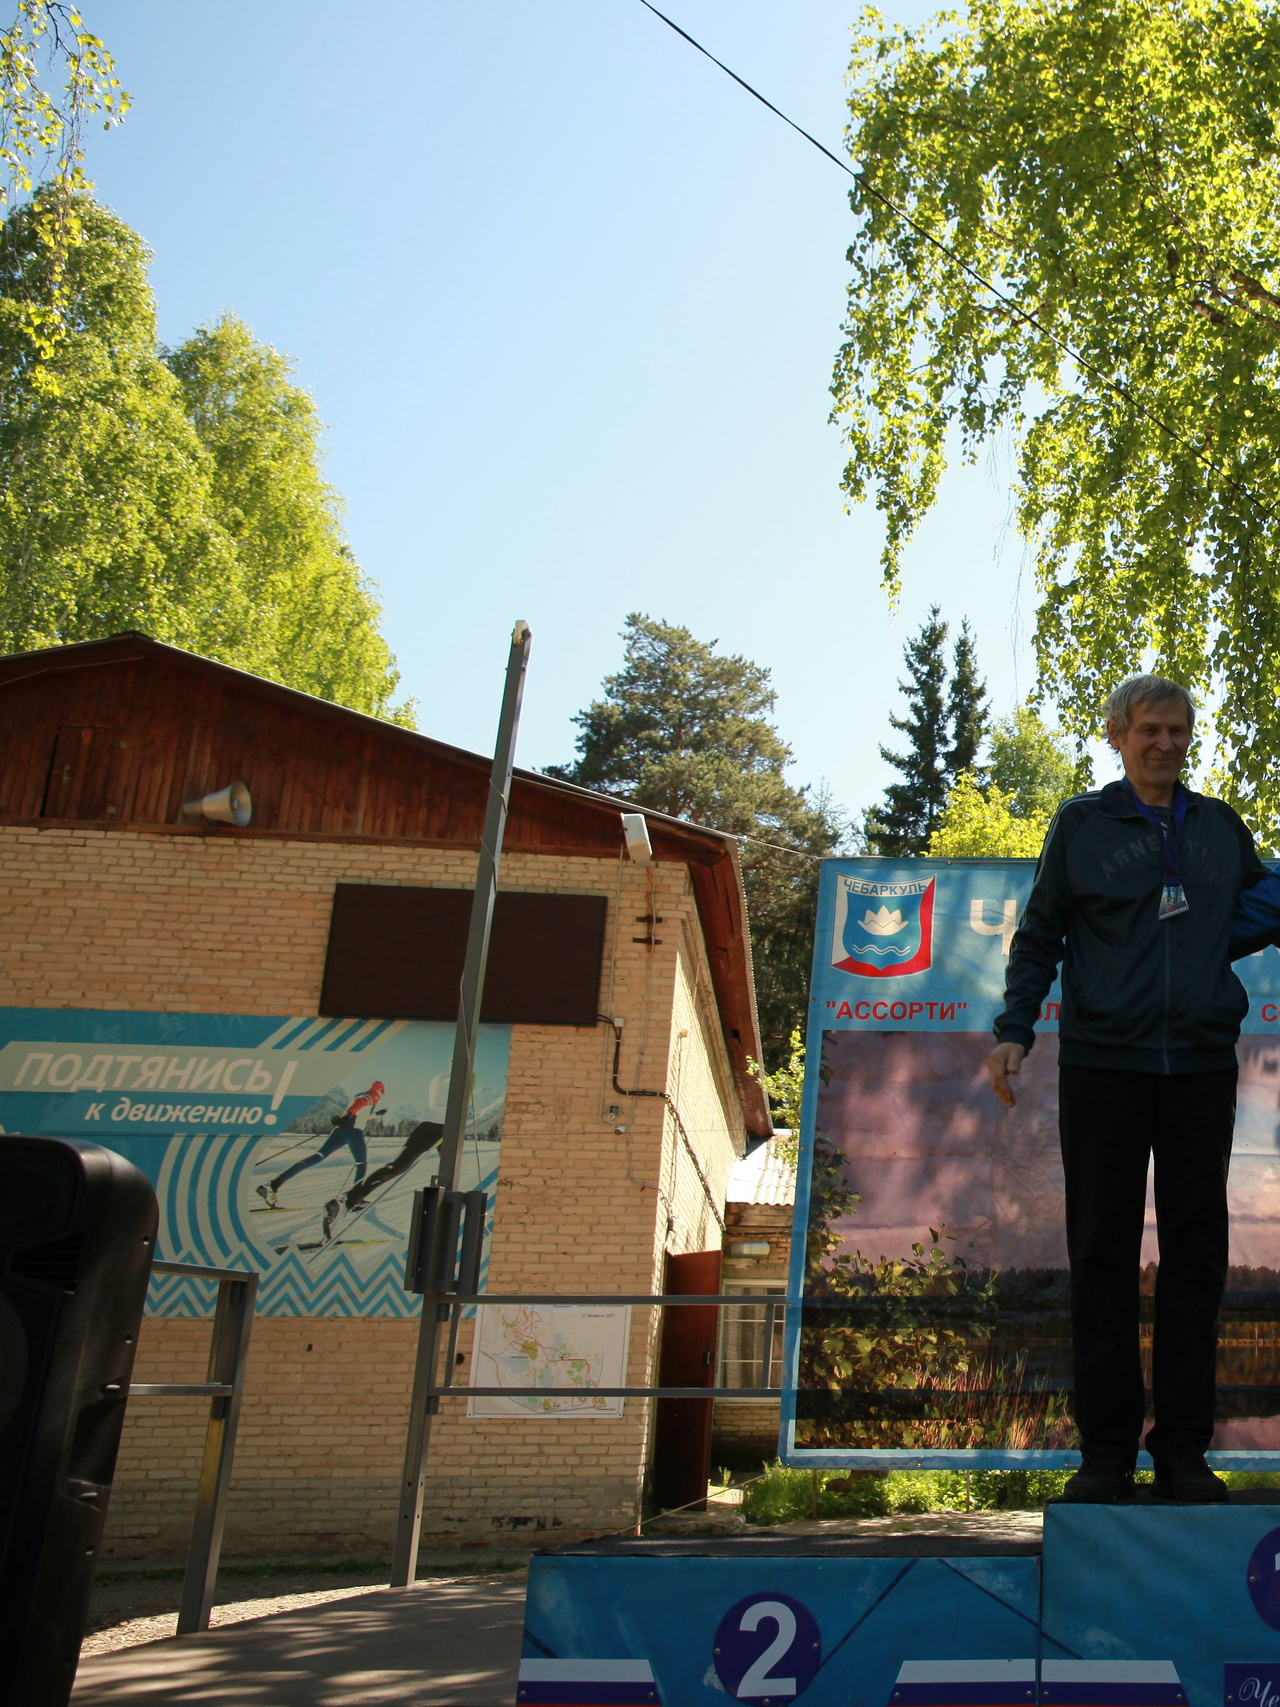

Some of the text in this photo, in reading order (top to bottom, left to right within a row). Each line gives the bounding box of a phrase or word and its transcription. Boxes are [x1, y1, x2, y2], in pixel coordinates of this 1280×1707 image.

[843, 879, 928, 896] ЧЕБАРКУЛЬ
[826, 1001, 968, 1021] "АССОРТИ"
[84, 1102, 106, 1121] к
[737, 1601, 797, 1698] 2
